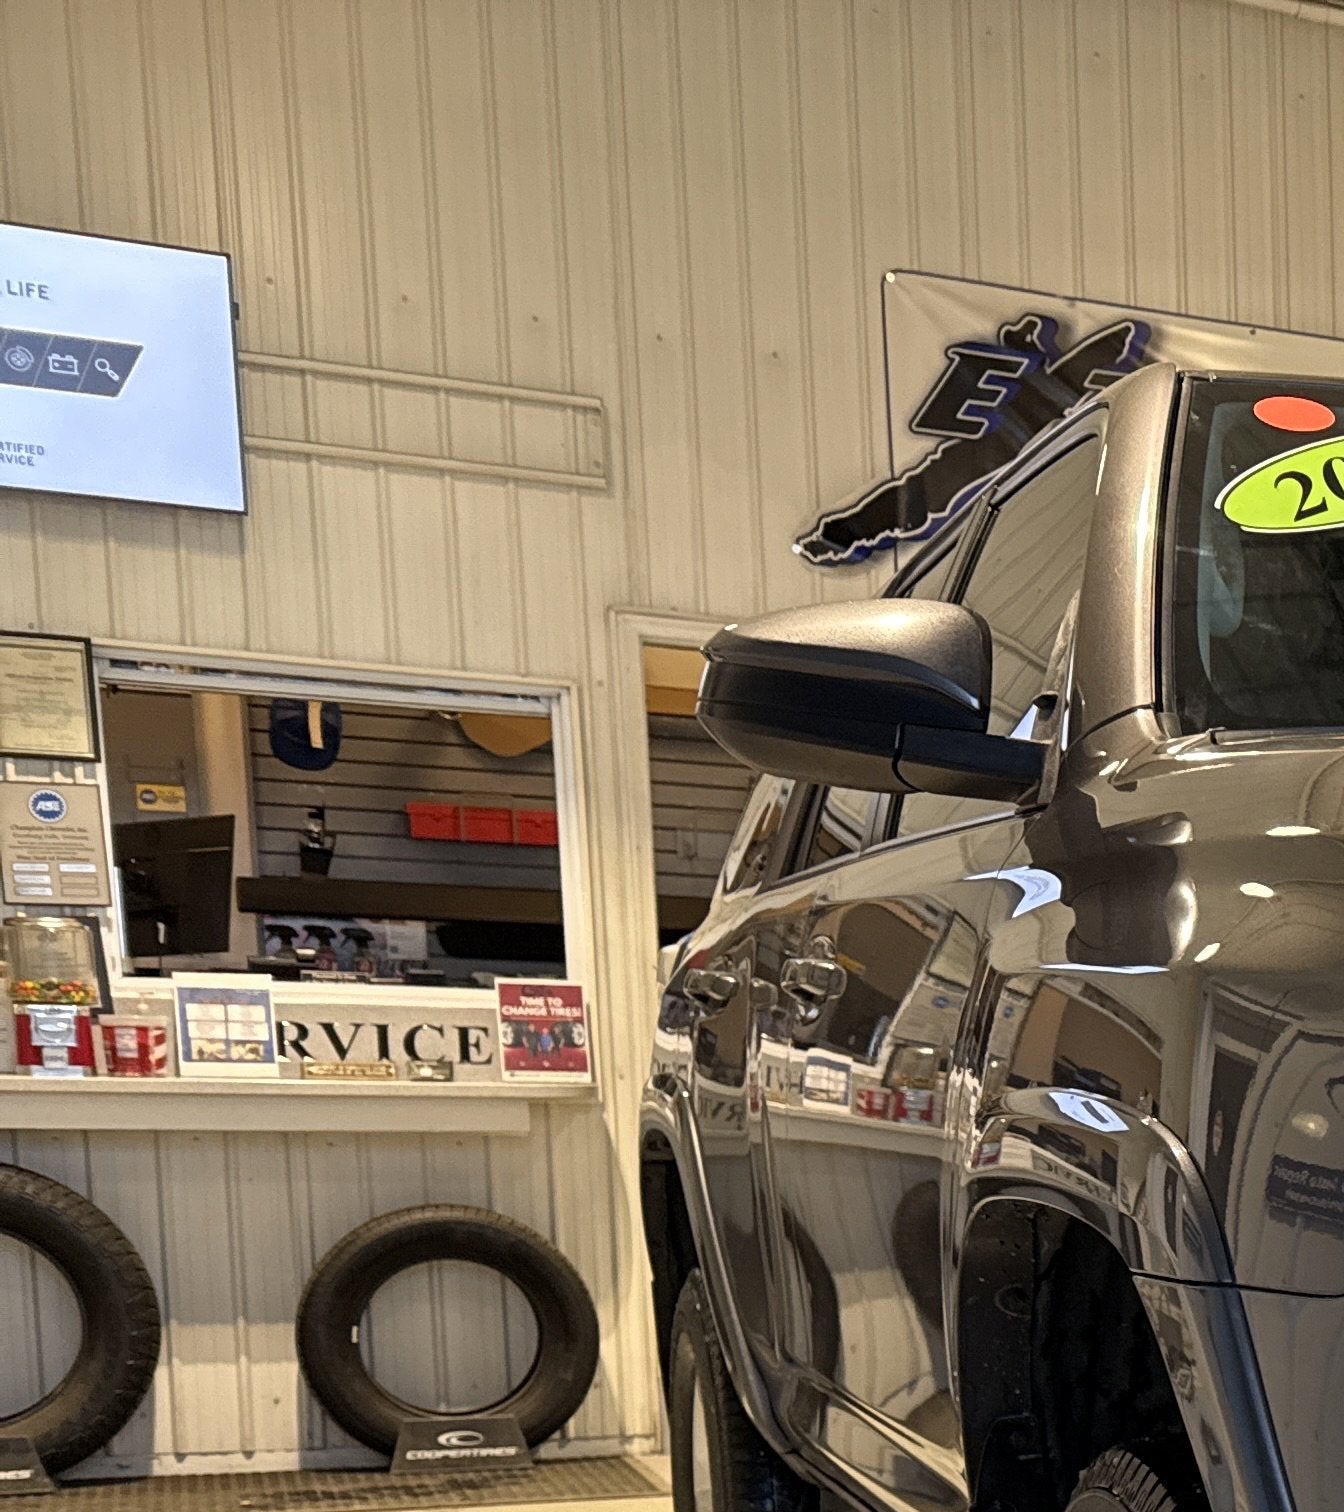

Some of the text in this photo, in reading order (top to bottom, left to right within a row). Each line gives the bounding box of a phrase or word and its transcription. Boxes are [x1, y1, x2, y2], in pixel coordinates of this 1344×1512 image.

[6, 279, 50, 300] LIFE
[0, 441, 45, 456] RTIFIED
[0, 451, 35, 467] RVICE
[546, 996, 564, 1007] TO
[276, 1020, 494, 1065] RVICE
